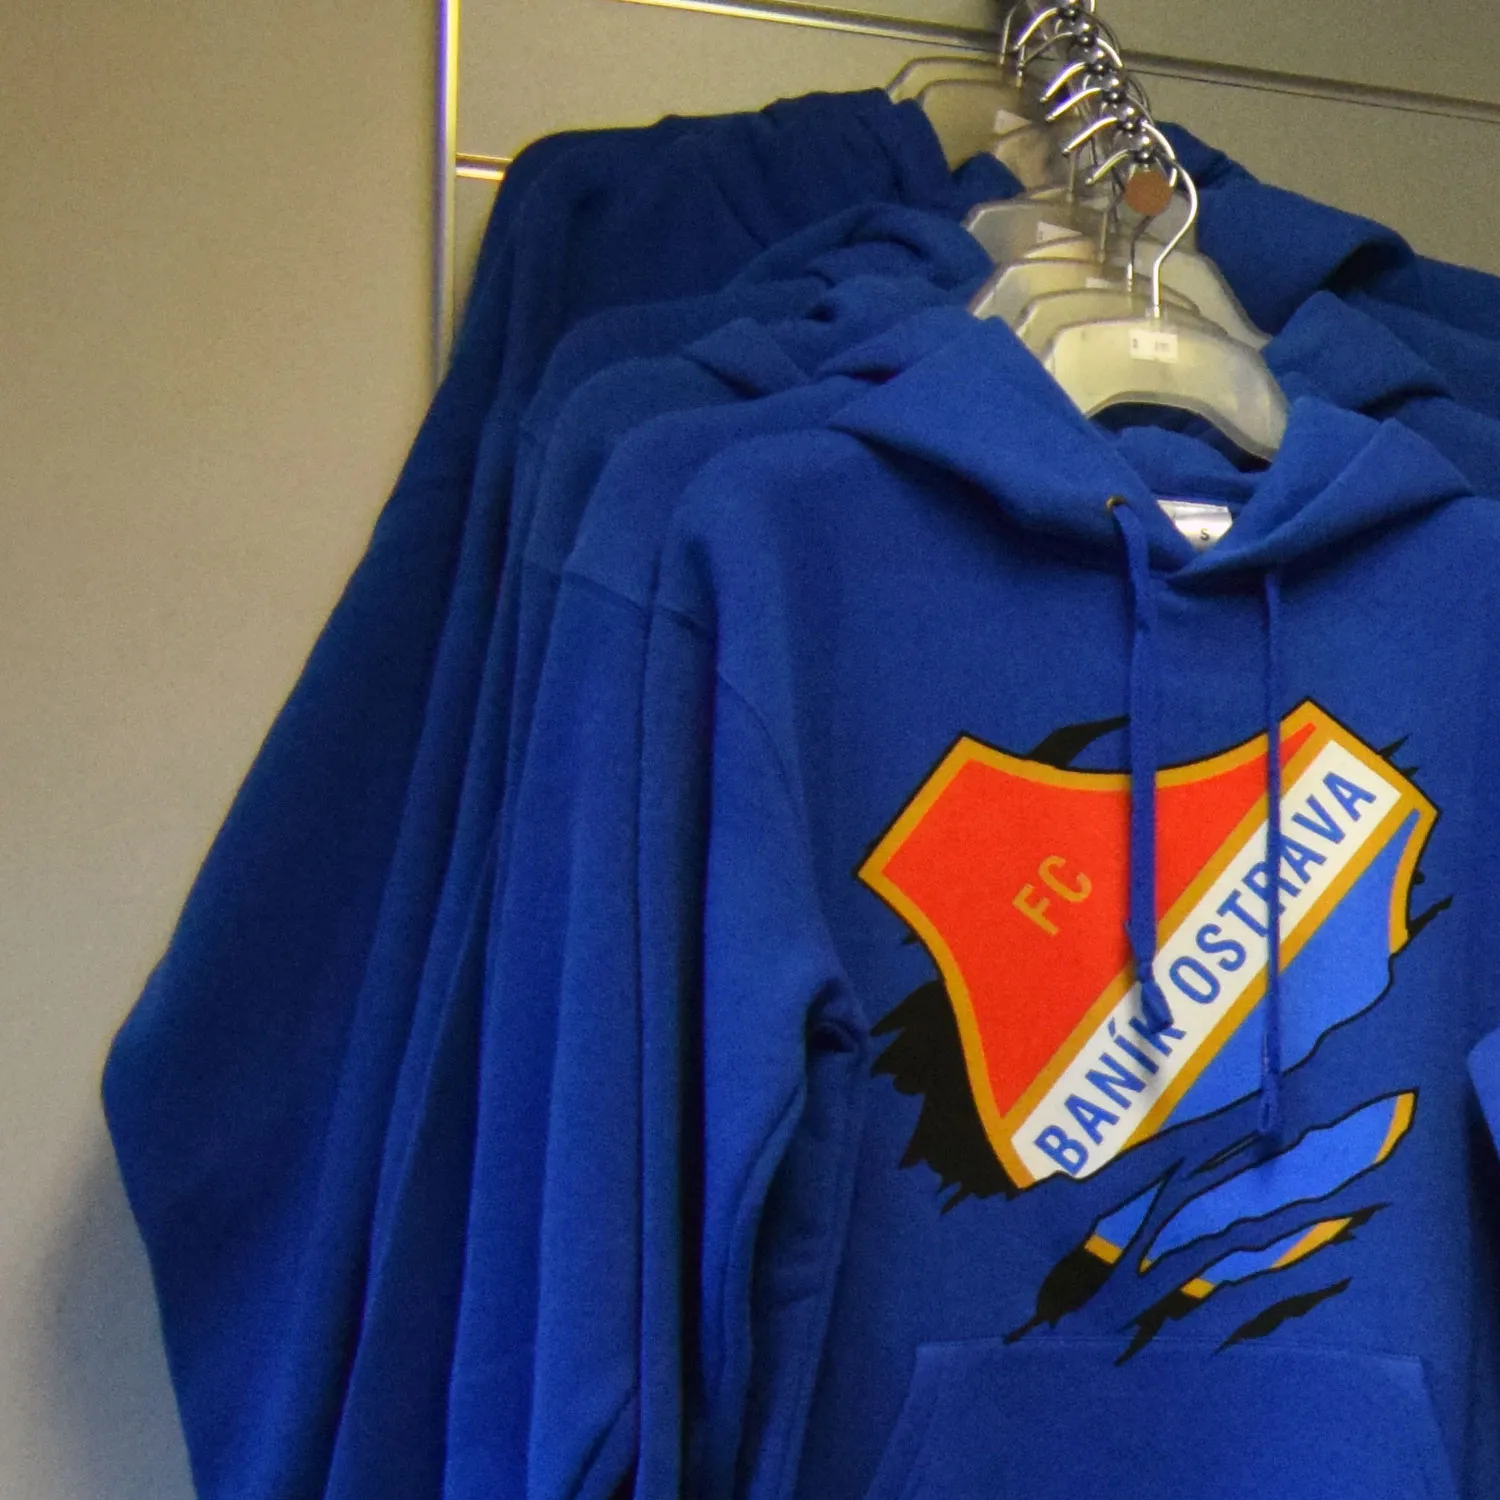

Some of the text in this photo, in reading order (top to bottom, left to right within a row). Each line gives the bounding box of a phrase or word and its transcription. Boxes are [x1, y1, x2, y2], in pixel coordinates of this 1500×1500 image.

[1199, 527, 1211, 542] S
[1011, 854, 1093, 937] FC
[1034, 770, 1378, 1176] BANÍK OSTRAVA
